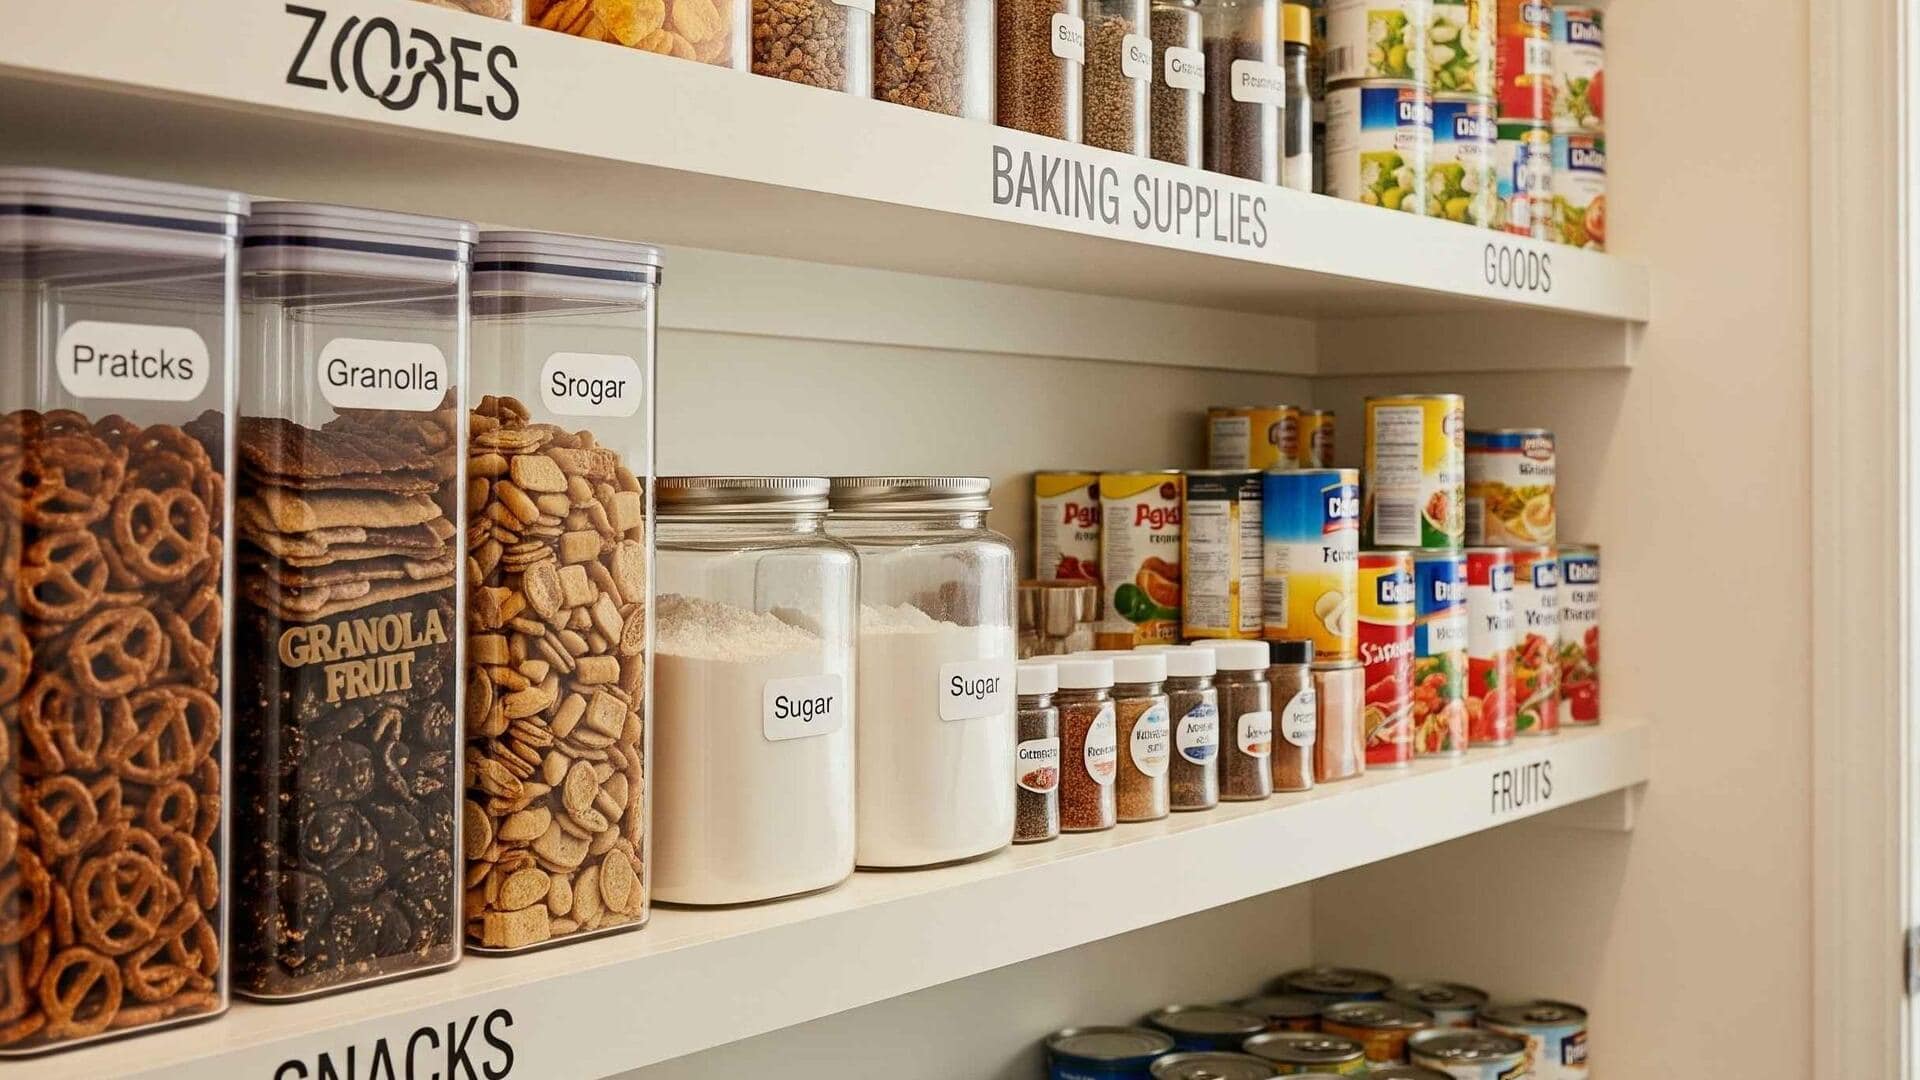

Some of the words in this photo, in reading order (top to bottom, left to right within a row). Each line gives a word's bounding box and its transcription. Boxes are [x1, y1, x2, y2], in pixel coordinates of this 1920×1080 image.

[992, 145, 1119, 226] BAKING
[1133, 173, 1268, 249] SUPPLIES
[1484, 243, 1552, 293] GOODS
[73, 344, 195, 381] Pratcks
[326, 357, 440, 392] Granolla
[551, 369, 626, 406] Srogar
[278, 608, 448, 668] GRANOLA
[324, 651, 416, 704] FRUIT
[950, 675, 1001, 701] Sugar
[774, 695, 834, 723] Sugar
[1491, 760, 1553, 814] FRUITS
[273, 1008, 515, 1080] ACKS
